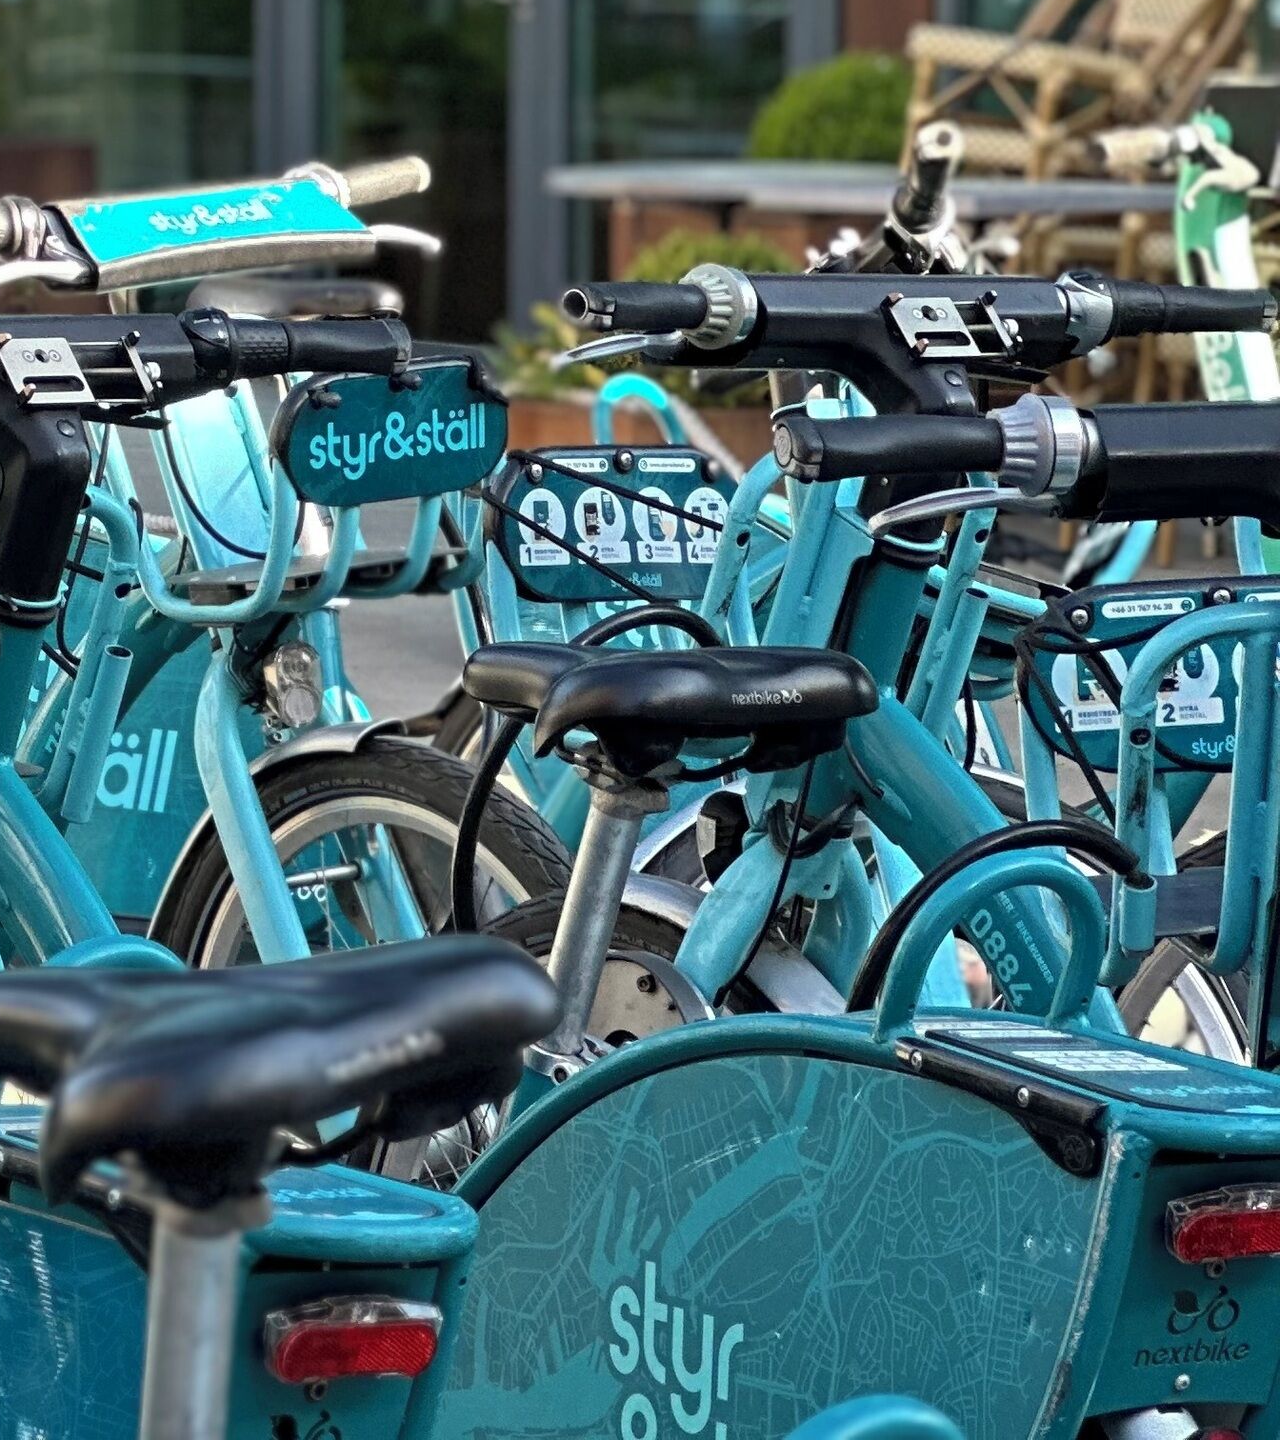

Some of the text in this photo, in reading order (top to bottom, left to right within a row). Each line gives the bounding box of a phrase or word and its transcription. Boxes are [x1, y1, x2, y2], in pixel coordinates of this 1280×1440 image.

[309, 402, 486, 481] styr&ställ
[525, 546, 532, 563] 1
[645, 543, 654, 559] 3
[690, 544, 700, 561] 4
[731, 689, 781, 706] nextbike
[1161, 702, 1176, 723] 2
[609, 1261, 744, 1434] styr
[1133, 1336, 1251, 1368] nextbike
